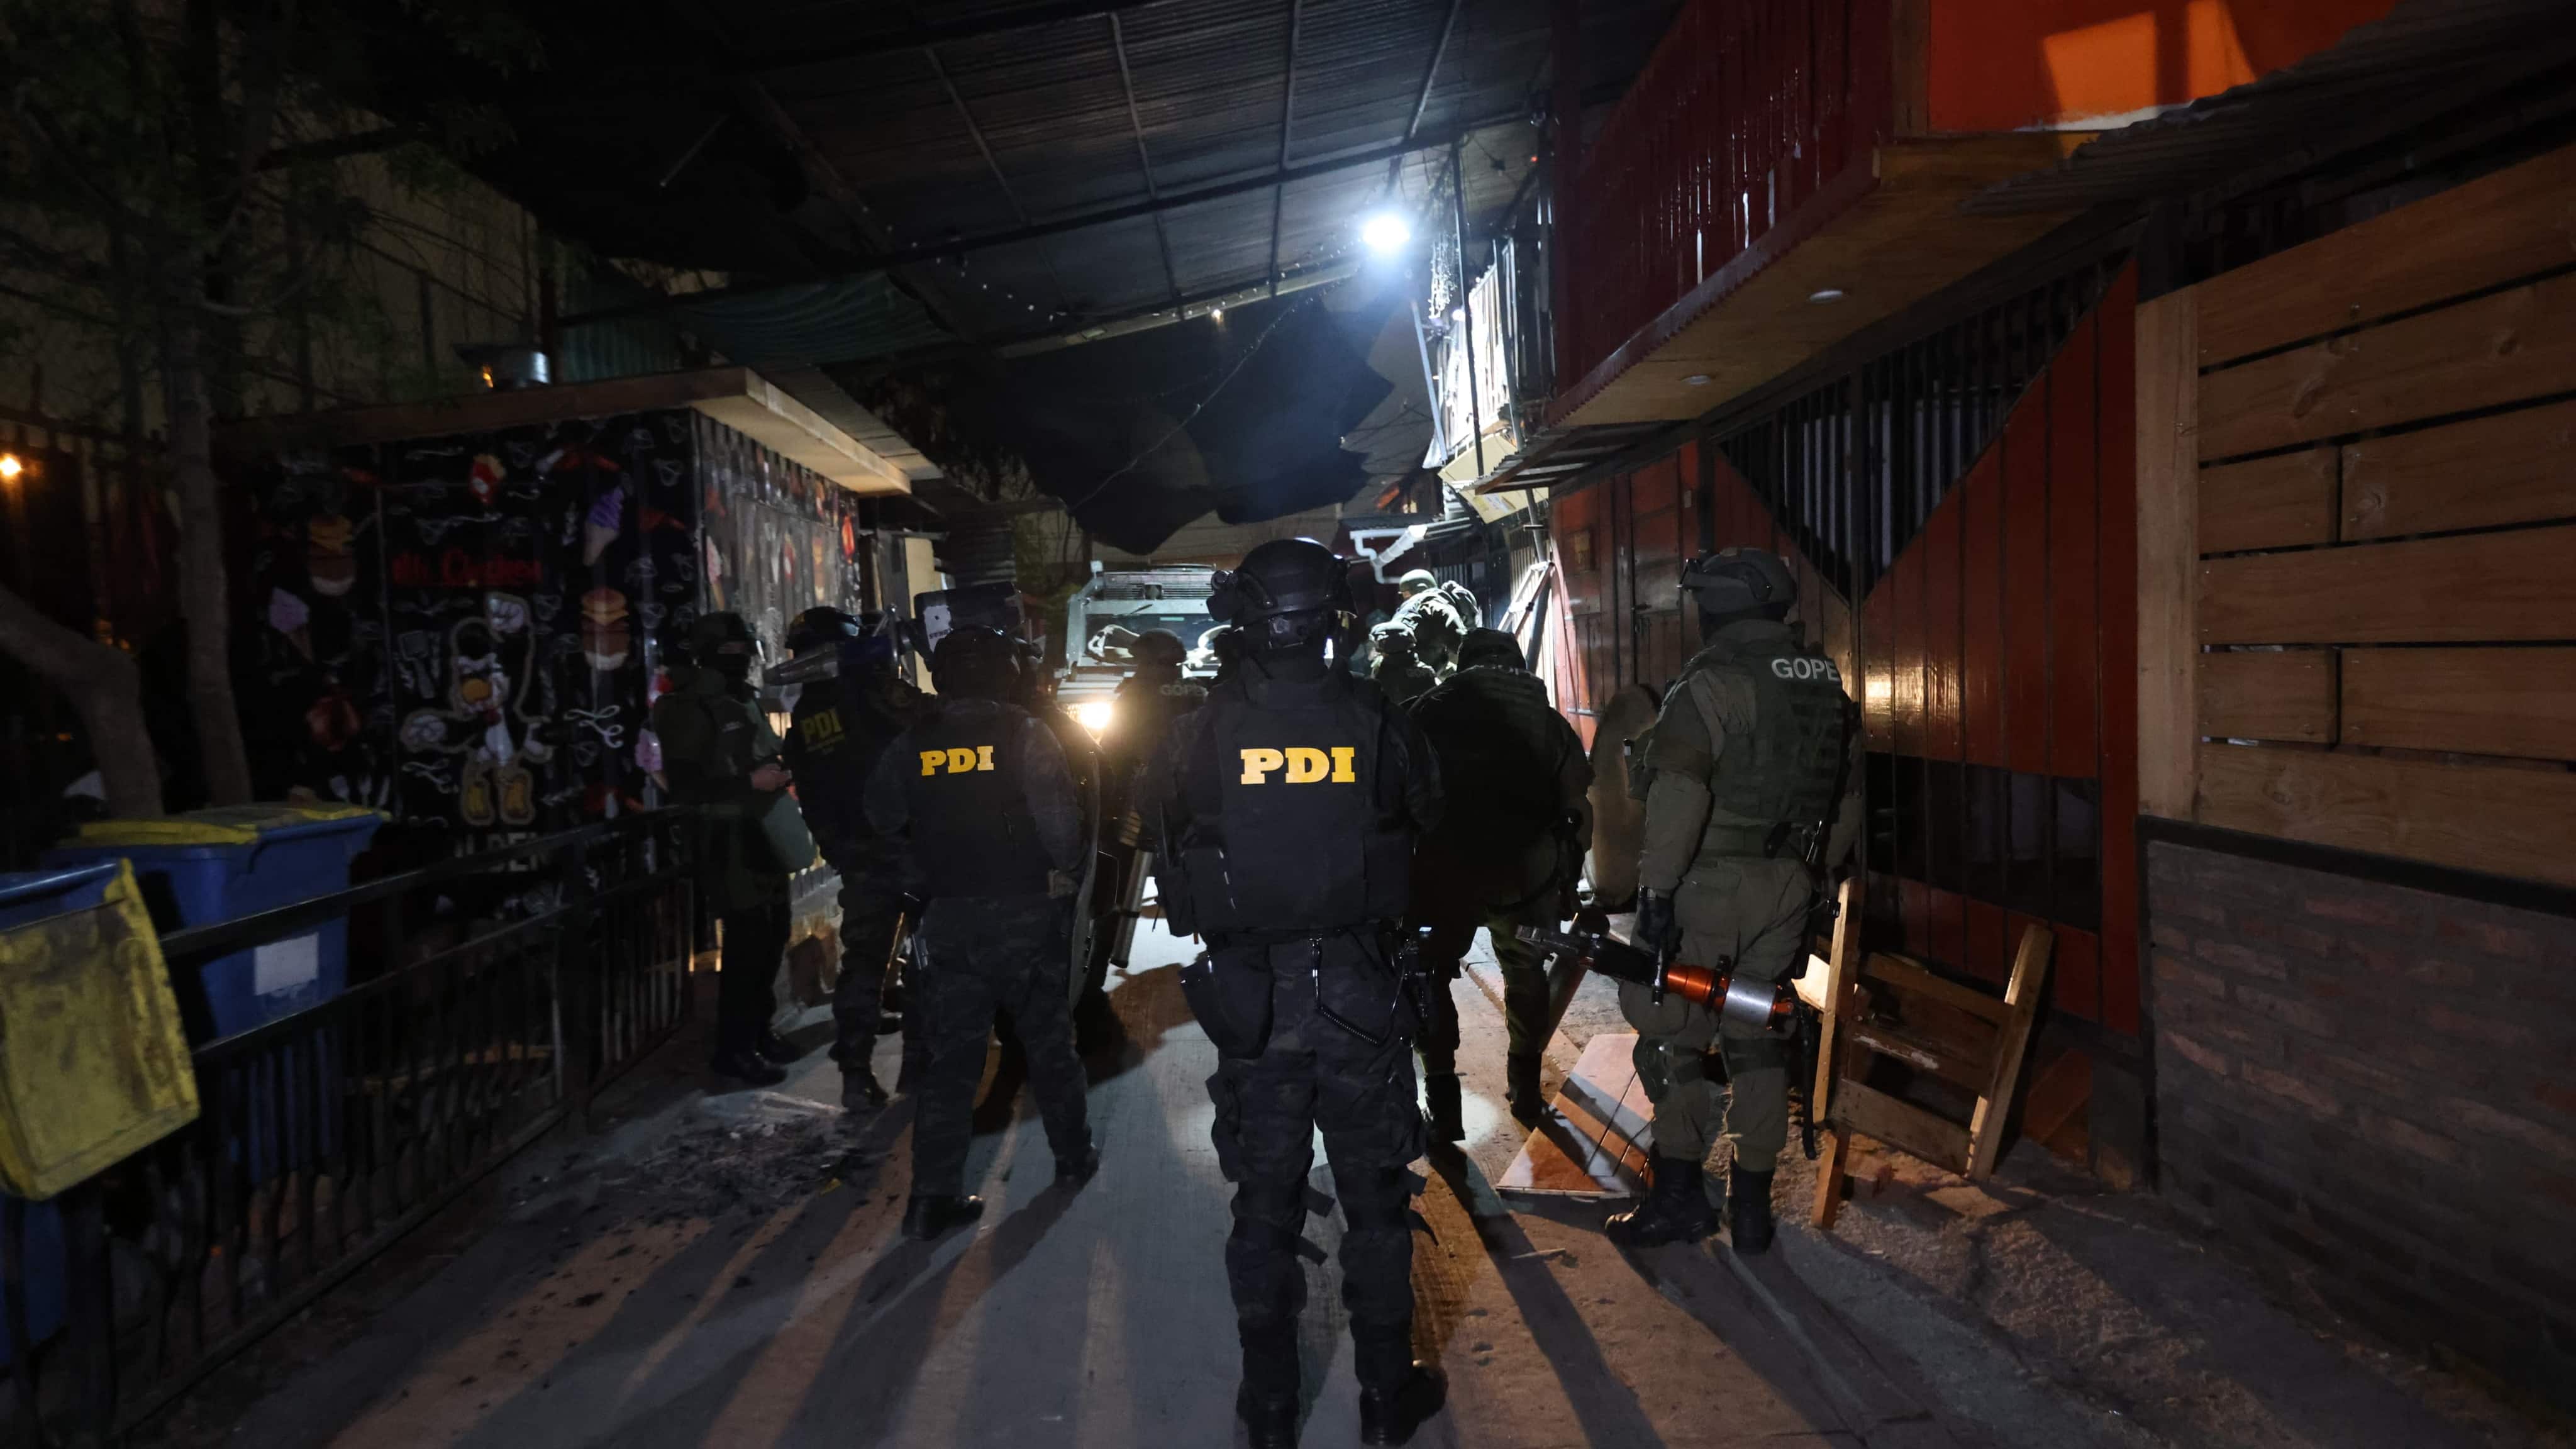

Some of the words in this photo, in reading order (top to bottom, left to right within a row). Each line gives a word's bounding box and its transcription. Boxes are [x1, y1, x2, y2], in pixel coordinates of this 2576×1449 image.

[1771, 658, 1841, 681] GOPE
[800, 708, 843, 746] PDI
[919, 745, 994, 776] PDI
[1240, 747, 1355, 785] PDI
